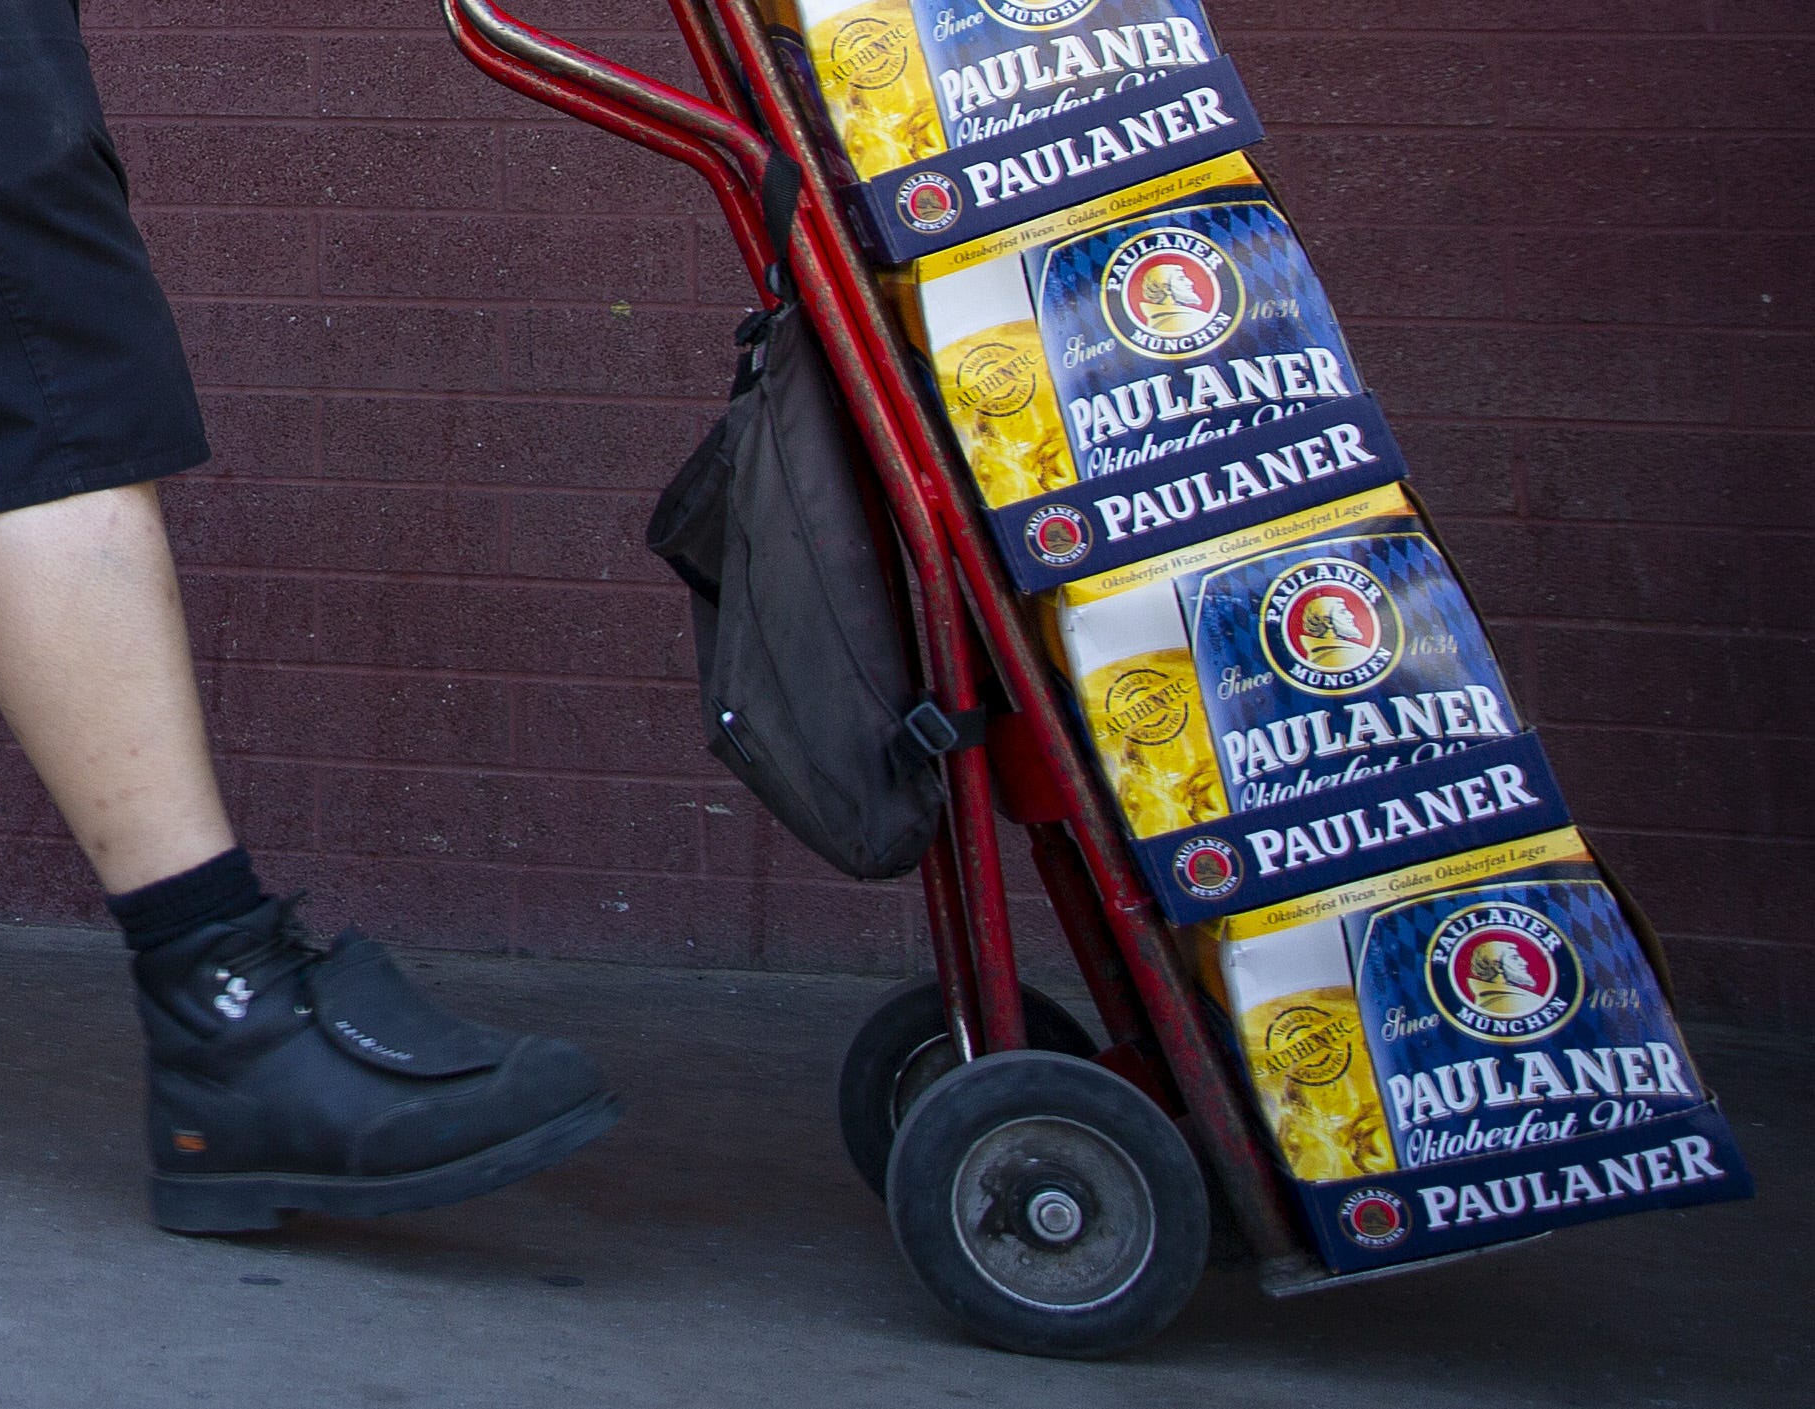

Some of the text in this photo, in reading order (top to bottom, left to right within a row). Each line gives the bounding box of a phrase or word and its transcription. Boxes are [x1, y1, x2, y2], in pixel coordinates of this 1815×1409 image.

[831, 23, 908, 83] AUTHENTIC
[931, 9, 988, 42] Since
[938, 12, 1206, 120] PAULANER
[962, 84, 1237, 208] PAULANER
[899, 172, 951, 205] PAULANER
[951, 234, 1019, 267] Oktoberfest
[1065, 204, 1108, 226] Golden
[1108, 181, 1177, 214] Oktoberfest
[1176, 169, 1215, 192] Lager
[1106, 233, 1224, 292] PAULANER
[1060, 300, 1299, 370] Since 1634
[1130, 309, 1232, 351] MÜNCHEN
[957, 349, 1037, 410] AUTHENTIC
[1068, 343, 1347, 450] PAULANER
[1093, 420, 1379, 542] PAULANER
[1027, 504, 1082, 538] PAULANER
[1099, 561, 1170, 592] Oktoberfest
[1217, 532, 1262, 554] Golden
[1262, 511, 1335, 543] Oktoberfest
[1332, 499, 1373, 521] Lager
[1266, 563, 1384, 624] PAULANER
[1215, 635, 1457, 701] Since 1634
[1289, 644, 1392, 687] MÜNCHEN
[1105, 678, 1189, 736] AUTHENTIC
[1222, 682, 1509, 784] PAULANER
[1245, 761, 1542, 876] PAULANER
[1176, 836, 1233, 870] PAULANER
[1265, 896, 1338, 927] Oktoberfest
[1387, 871, 1433, 892] Golden
[1433, 852, 1509, 883] Oktoberfest
[1507, 841, 1550, 864] Lager
[1432, 907, 1563, 965] PAULANER
[1379, 990, 1640, 1043] Since 1634
[1455, 994, 1569, 1033] MÜNCHEN
[1266, 1017, 1353, 1074] AUTHENTIC
[1386, 1039, 1694, 1130] PAULANER
[1405, 1107, 1578, 1166] Oktoberfest
[1342, 1187, 1402, 1218] PAULANER
[1416, 1133, 1728, 1229] PAULANER
